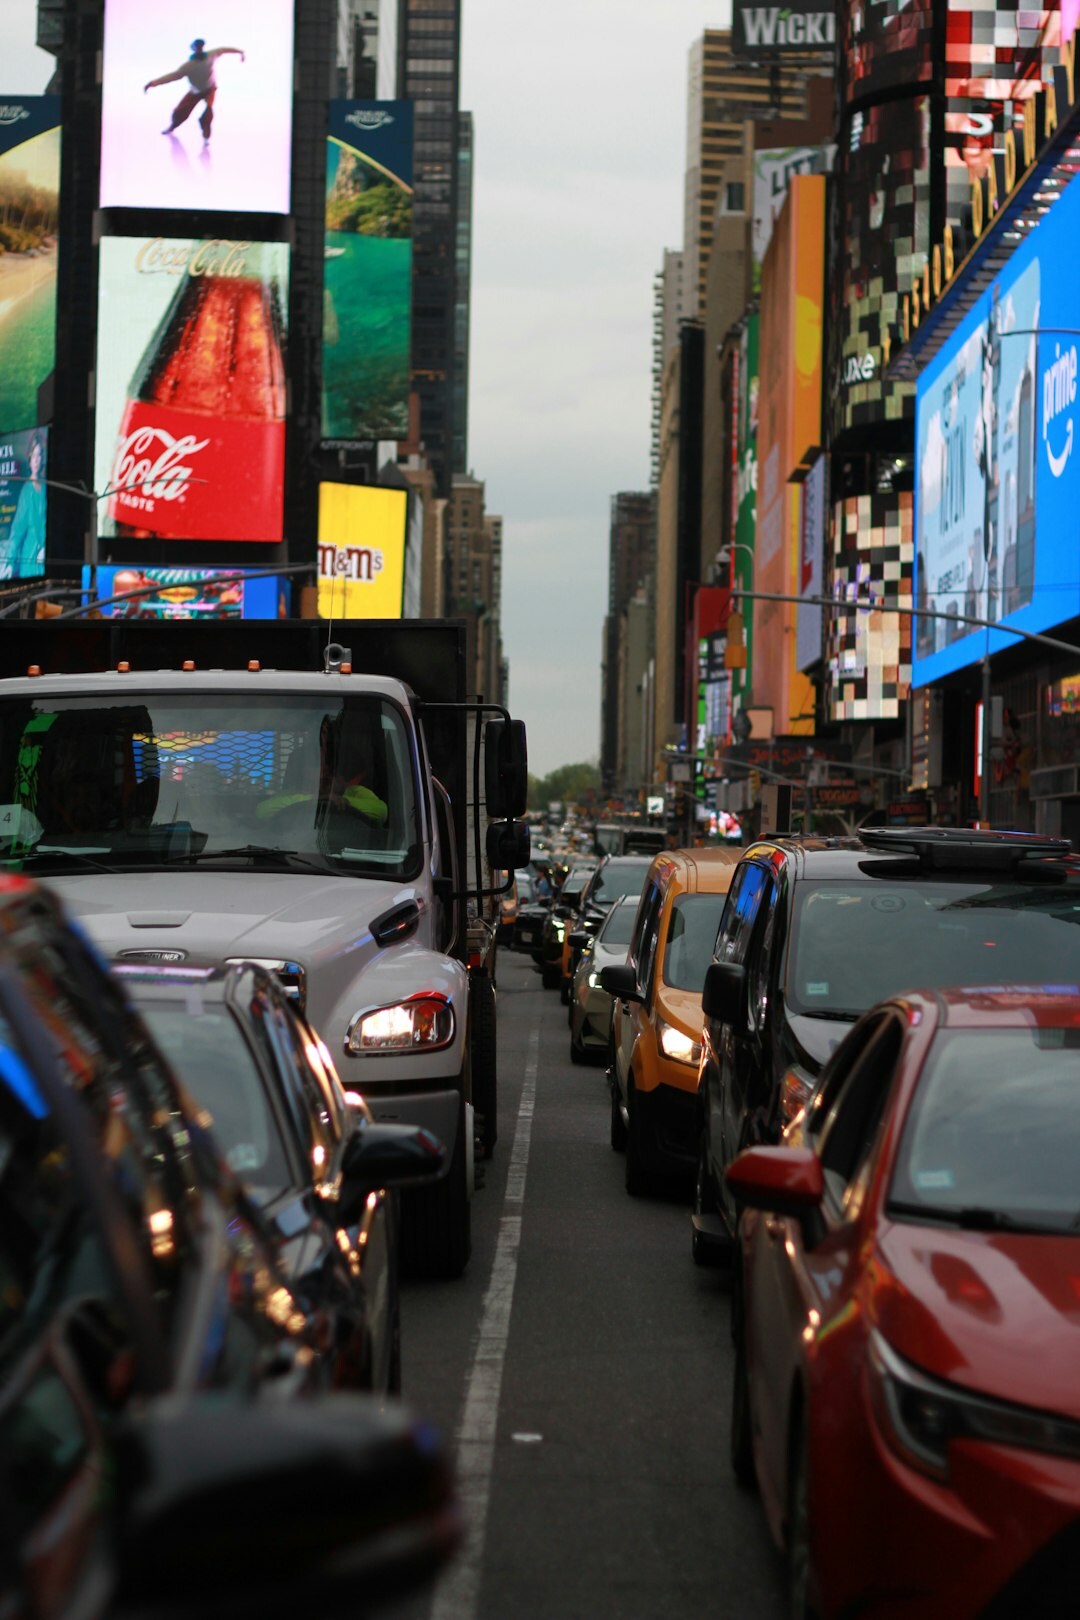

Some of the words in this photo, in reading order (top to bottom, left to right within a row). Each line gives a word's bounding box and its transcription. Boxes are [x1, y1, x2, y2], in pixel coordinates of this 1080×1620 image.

[943, 29, 1076, 284] BOADWAY
[1043, 342, 1077, 441] prime
[113, 426, 211, 501] Cola
[119, 492, 155, 512] TASTE
[3, 812, 12, 824] 4
